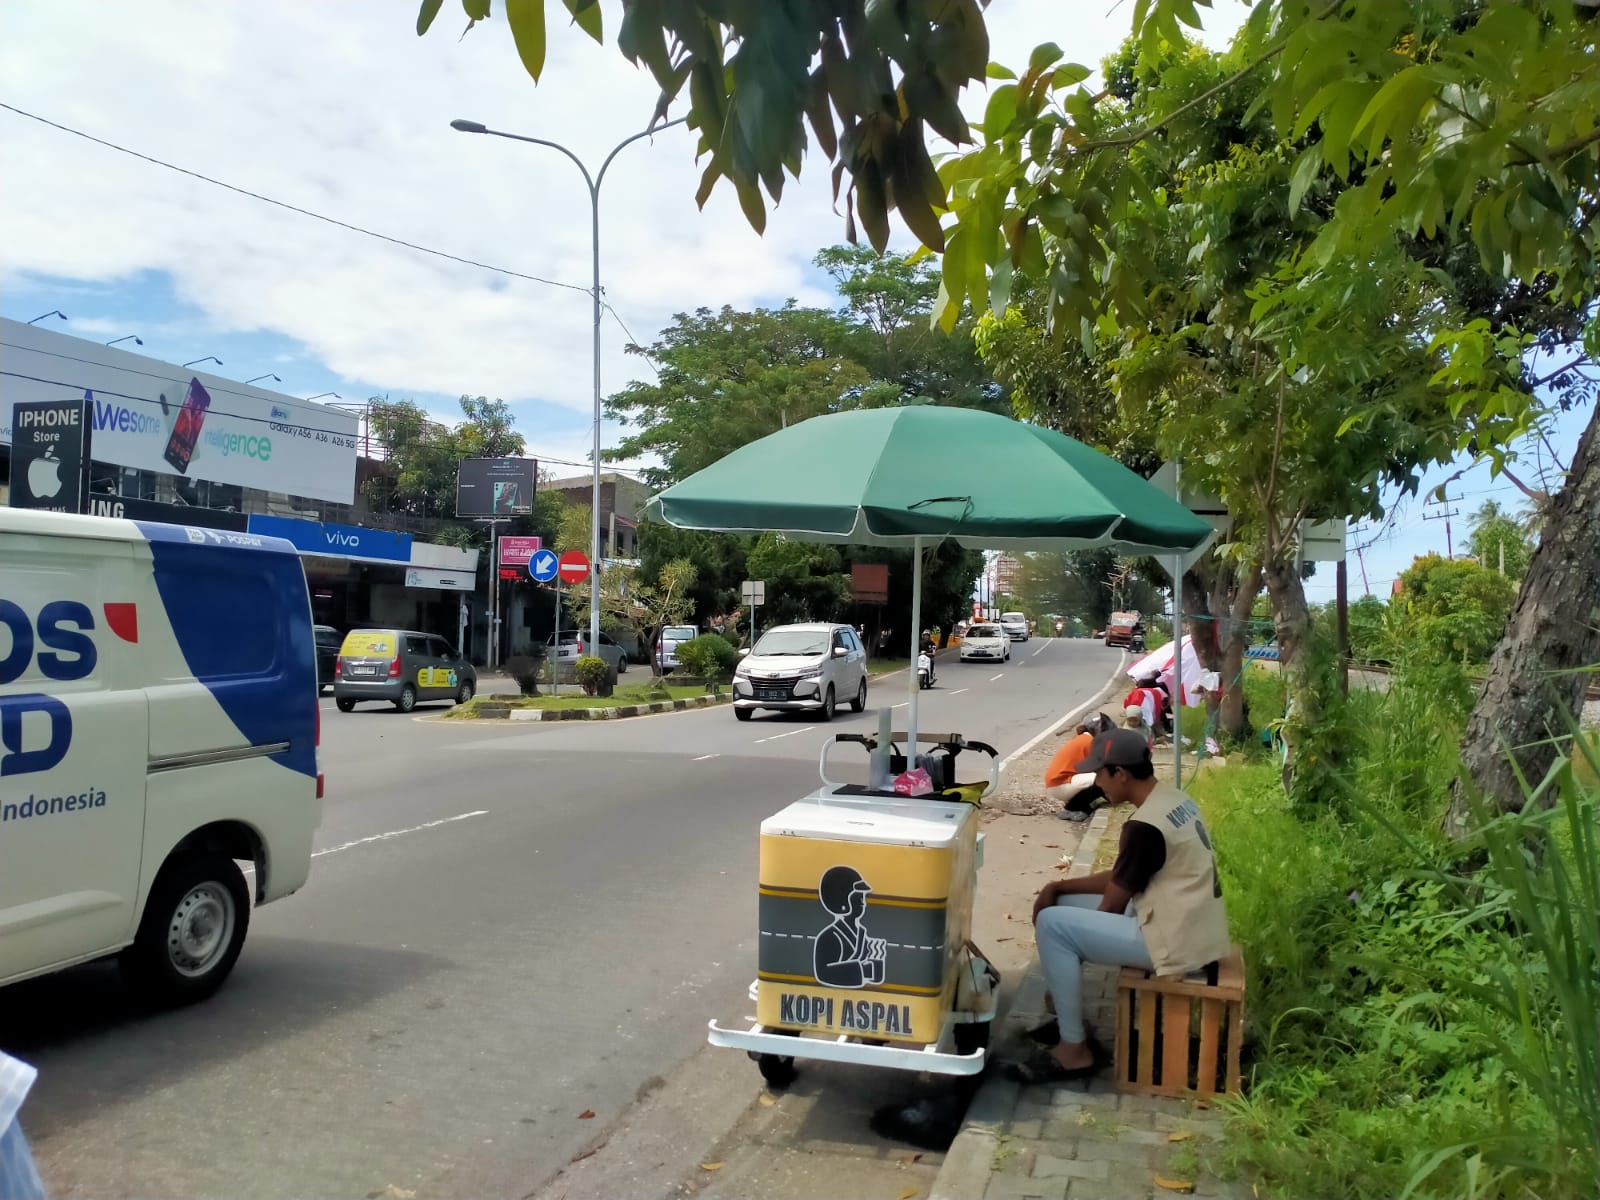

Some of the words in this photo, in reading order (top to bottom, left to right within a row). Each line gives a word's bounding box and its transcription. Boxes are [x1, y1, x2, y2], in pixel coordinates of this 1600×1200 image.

[19, 409, 79, 428] IPHONE
[33, 431, 61, 442] Store
[269, 422, 298, 438] Galaxy
[298, 428, 312, 439] A56
[315, 432, 329, 443] A36
[332, 436, 345, 447] A26
[345, 439, 355, 448] 5G
[326, 530, 360, 547] vivo
[780, 993, 834, 1027] KOPI
[840, 999, 913, 1035] ASPAL
